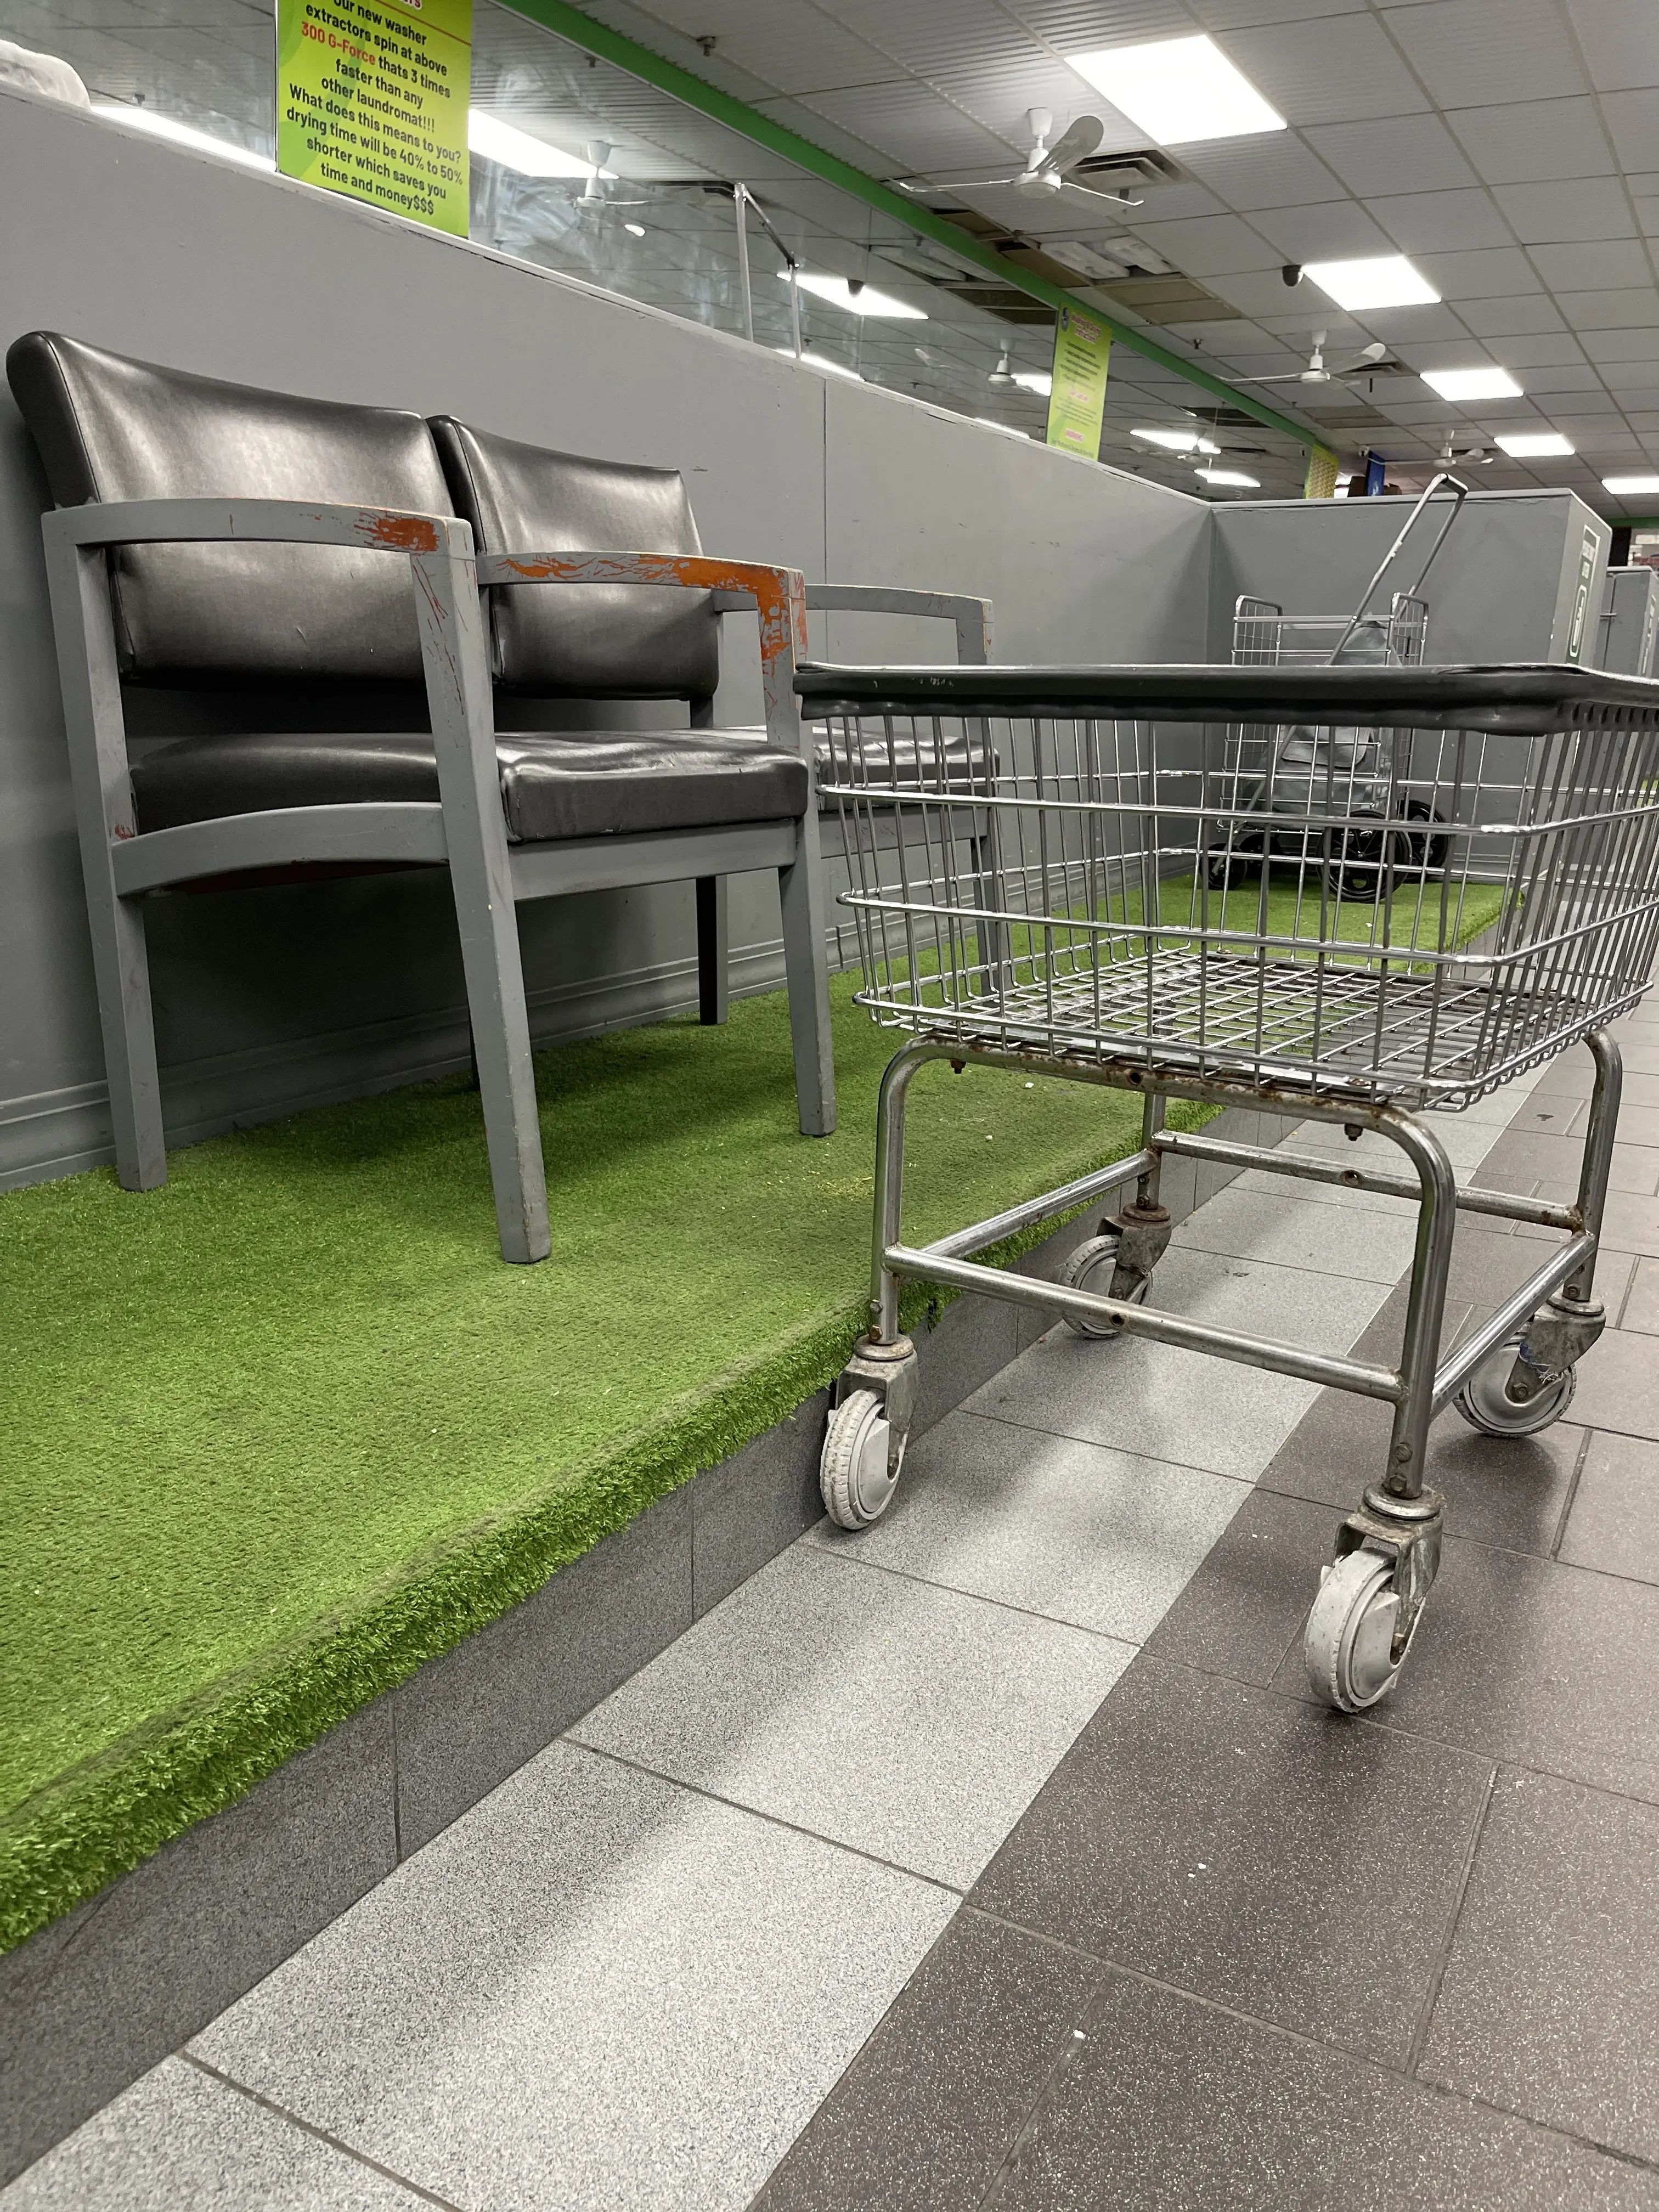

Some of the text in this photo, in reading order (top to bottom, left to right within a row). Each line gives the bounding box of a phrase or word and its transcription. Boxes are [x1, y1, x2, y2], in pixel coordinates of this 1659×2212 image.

[306, 4, 447, 76] extractors spin at above
[358, 4, 382, 25] new
[385, 18, 427, 46] washer
[302, 21, 450, 98] 300 G-Force thats 3 times
[336, 59, 423, 109] faster than any
[290, 83, 461, 163] What does this means to you?
[321, 78, 435, 133] other laundromat!!!
[287, 106, 463, 185] drying time will be 40% to 50%
[307, 137, 446, 199] shorter which saves you
[321, 162, 434, 216] time and money$$$
